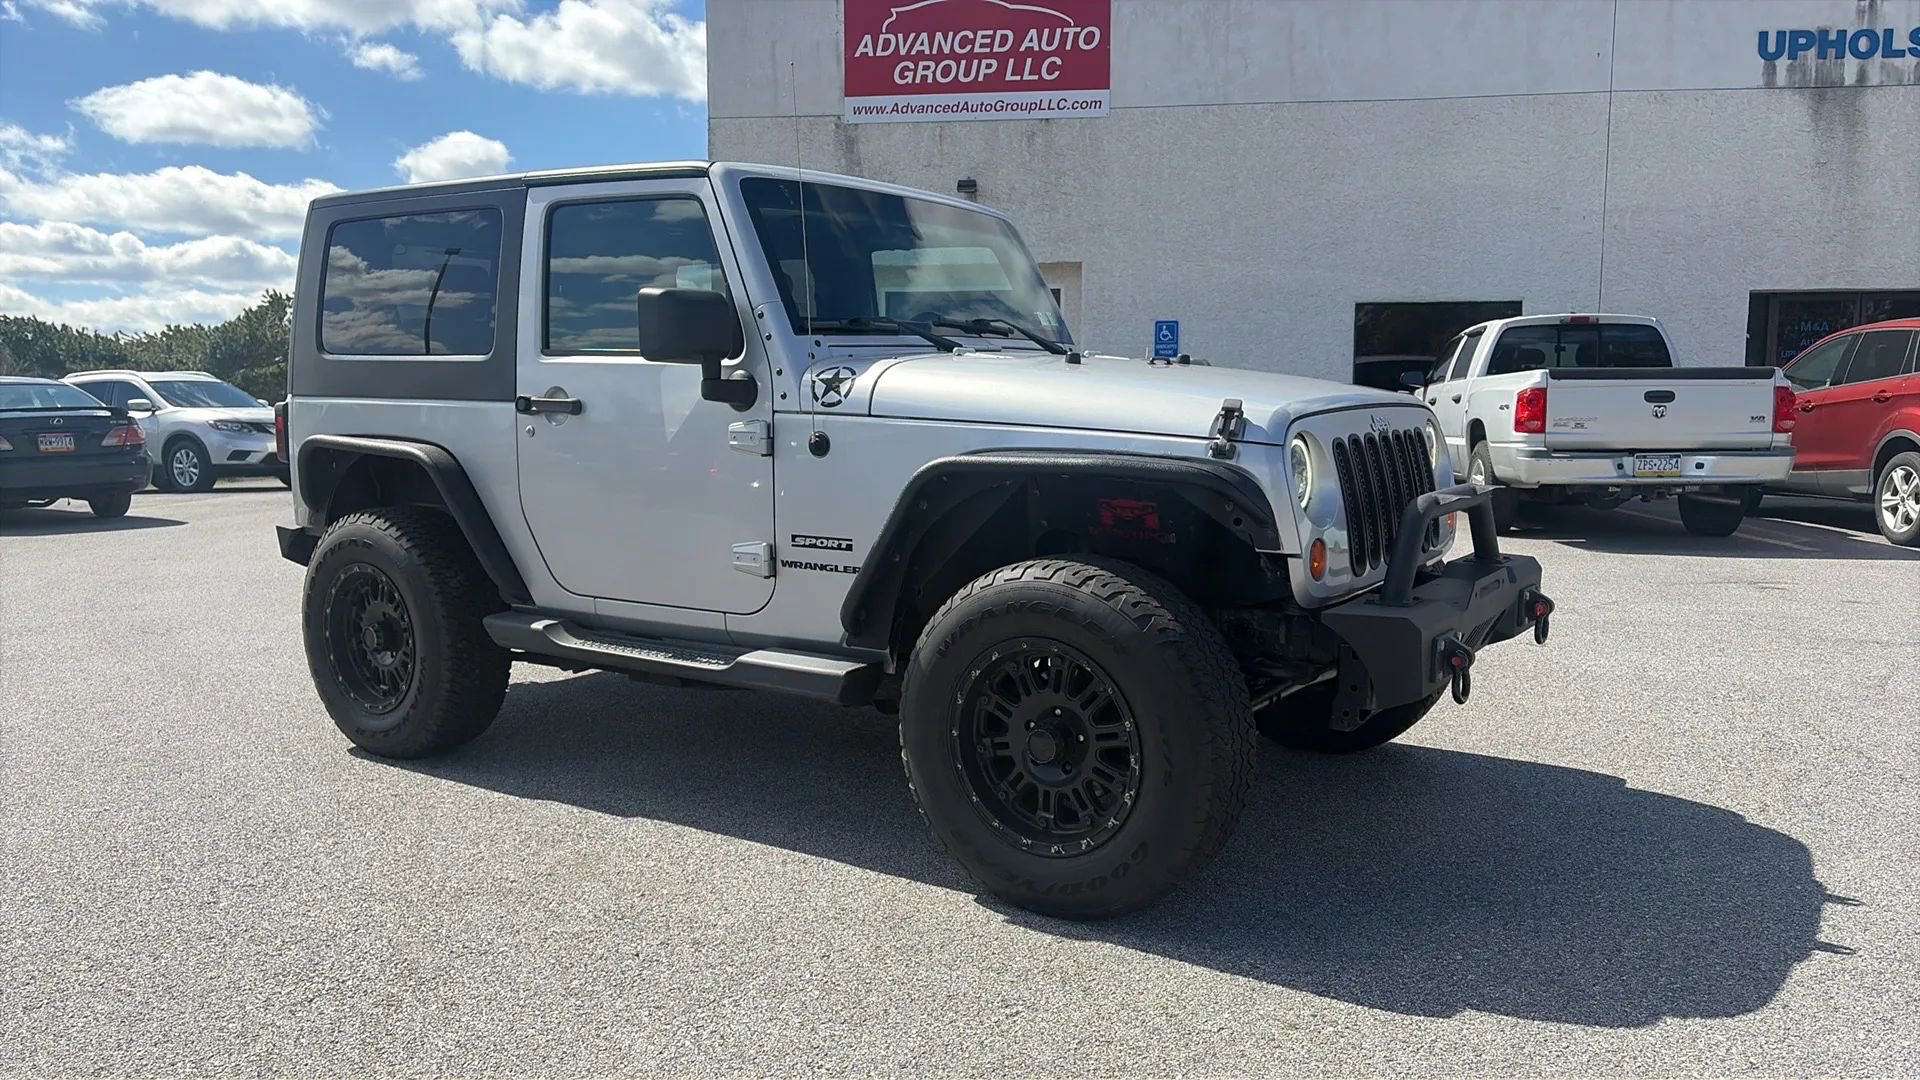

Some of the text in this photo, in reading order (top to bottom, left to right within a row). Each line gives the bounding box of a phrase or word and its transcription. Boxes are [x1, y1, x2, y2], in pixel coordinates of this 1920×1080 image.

[854, 26, 1101, 57] ADVANCED AUTO
[893, 56, 1063, 84] GROUP LLC
[852, 98, 1102, 116] www.AdvancedAutoGroupLLC.com
[794, 536, 852, 549] SPORT
